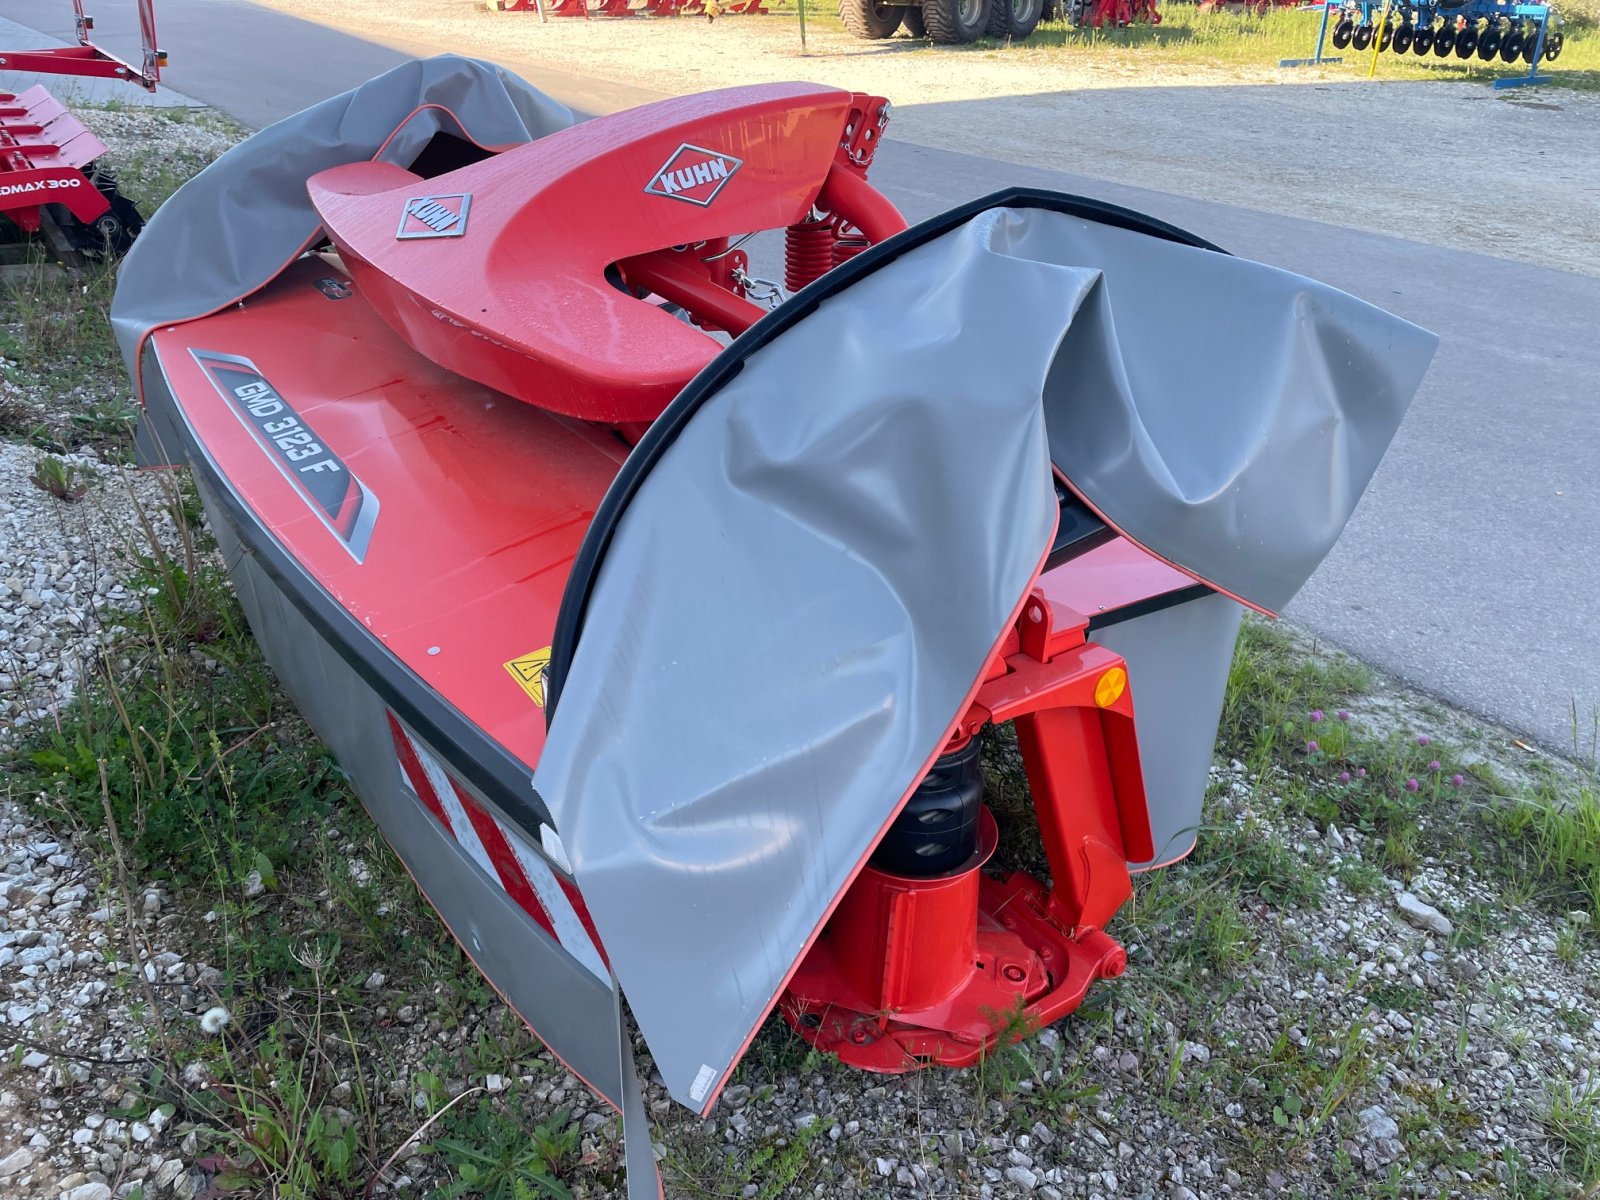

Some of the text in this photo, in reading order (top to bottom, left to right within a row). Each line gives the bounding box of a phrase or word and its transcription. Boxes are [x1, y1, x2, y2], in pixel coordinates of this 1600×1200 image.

[0, 178, 81, 196] DMAX 300
[659, 157, 728, 194] KUHN
[407, 196, 461, 232] KUHN
[233, 381, 340, 474] GMD 3123 F
